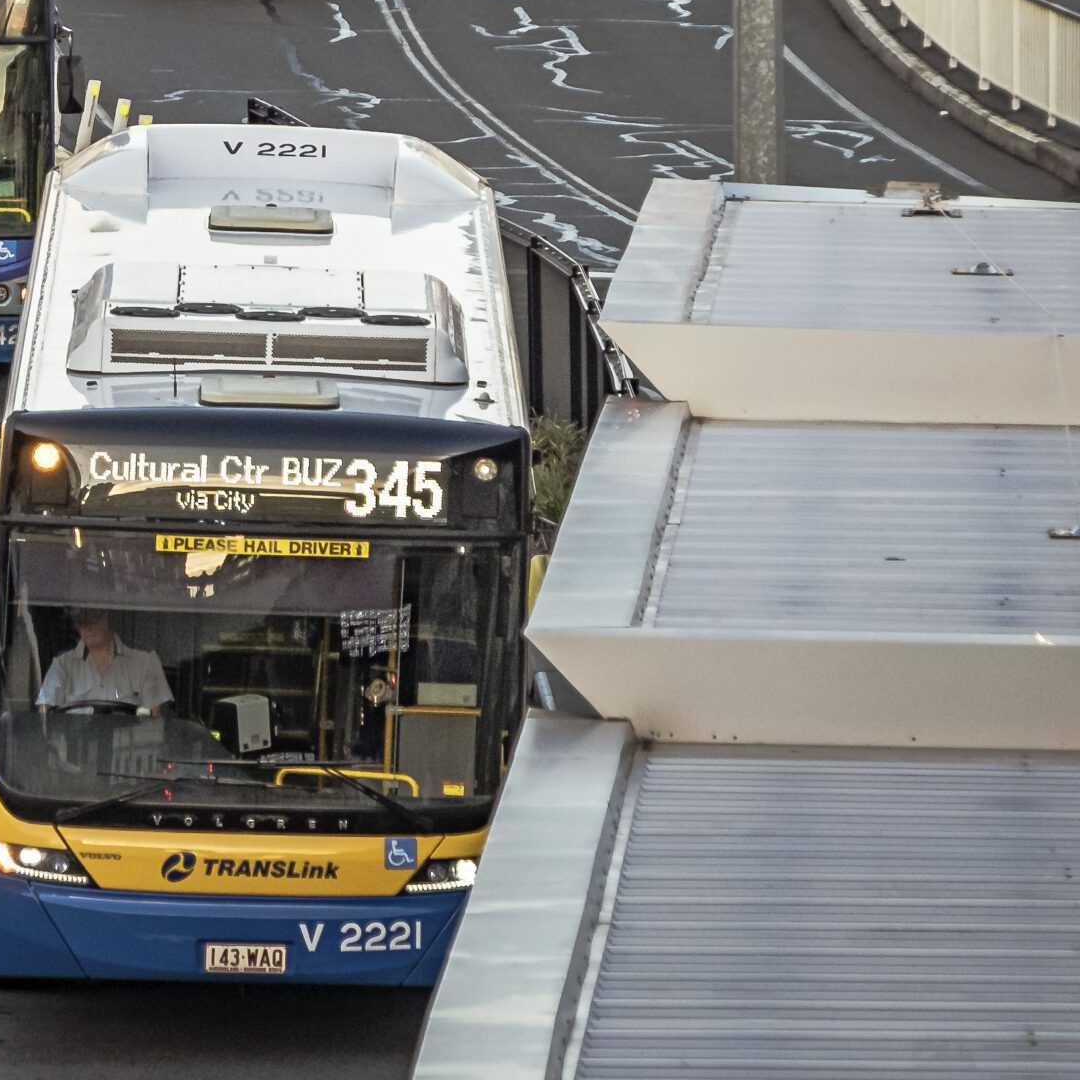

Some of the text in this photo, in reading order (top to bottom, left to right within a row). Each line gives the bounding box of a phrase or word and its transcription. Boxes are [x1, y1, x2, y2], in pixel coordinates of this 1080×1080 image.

[90, 451, 444, 518] Cultural Ctr BUZ 345
[176, 489, 256, 513] via City
[173, 537, 352, 556] PLEASE HAIL DRIVER
[203, 858, 340, 880] TRANSLink
